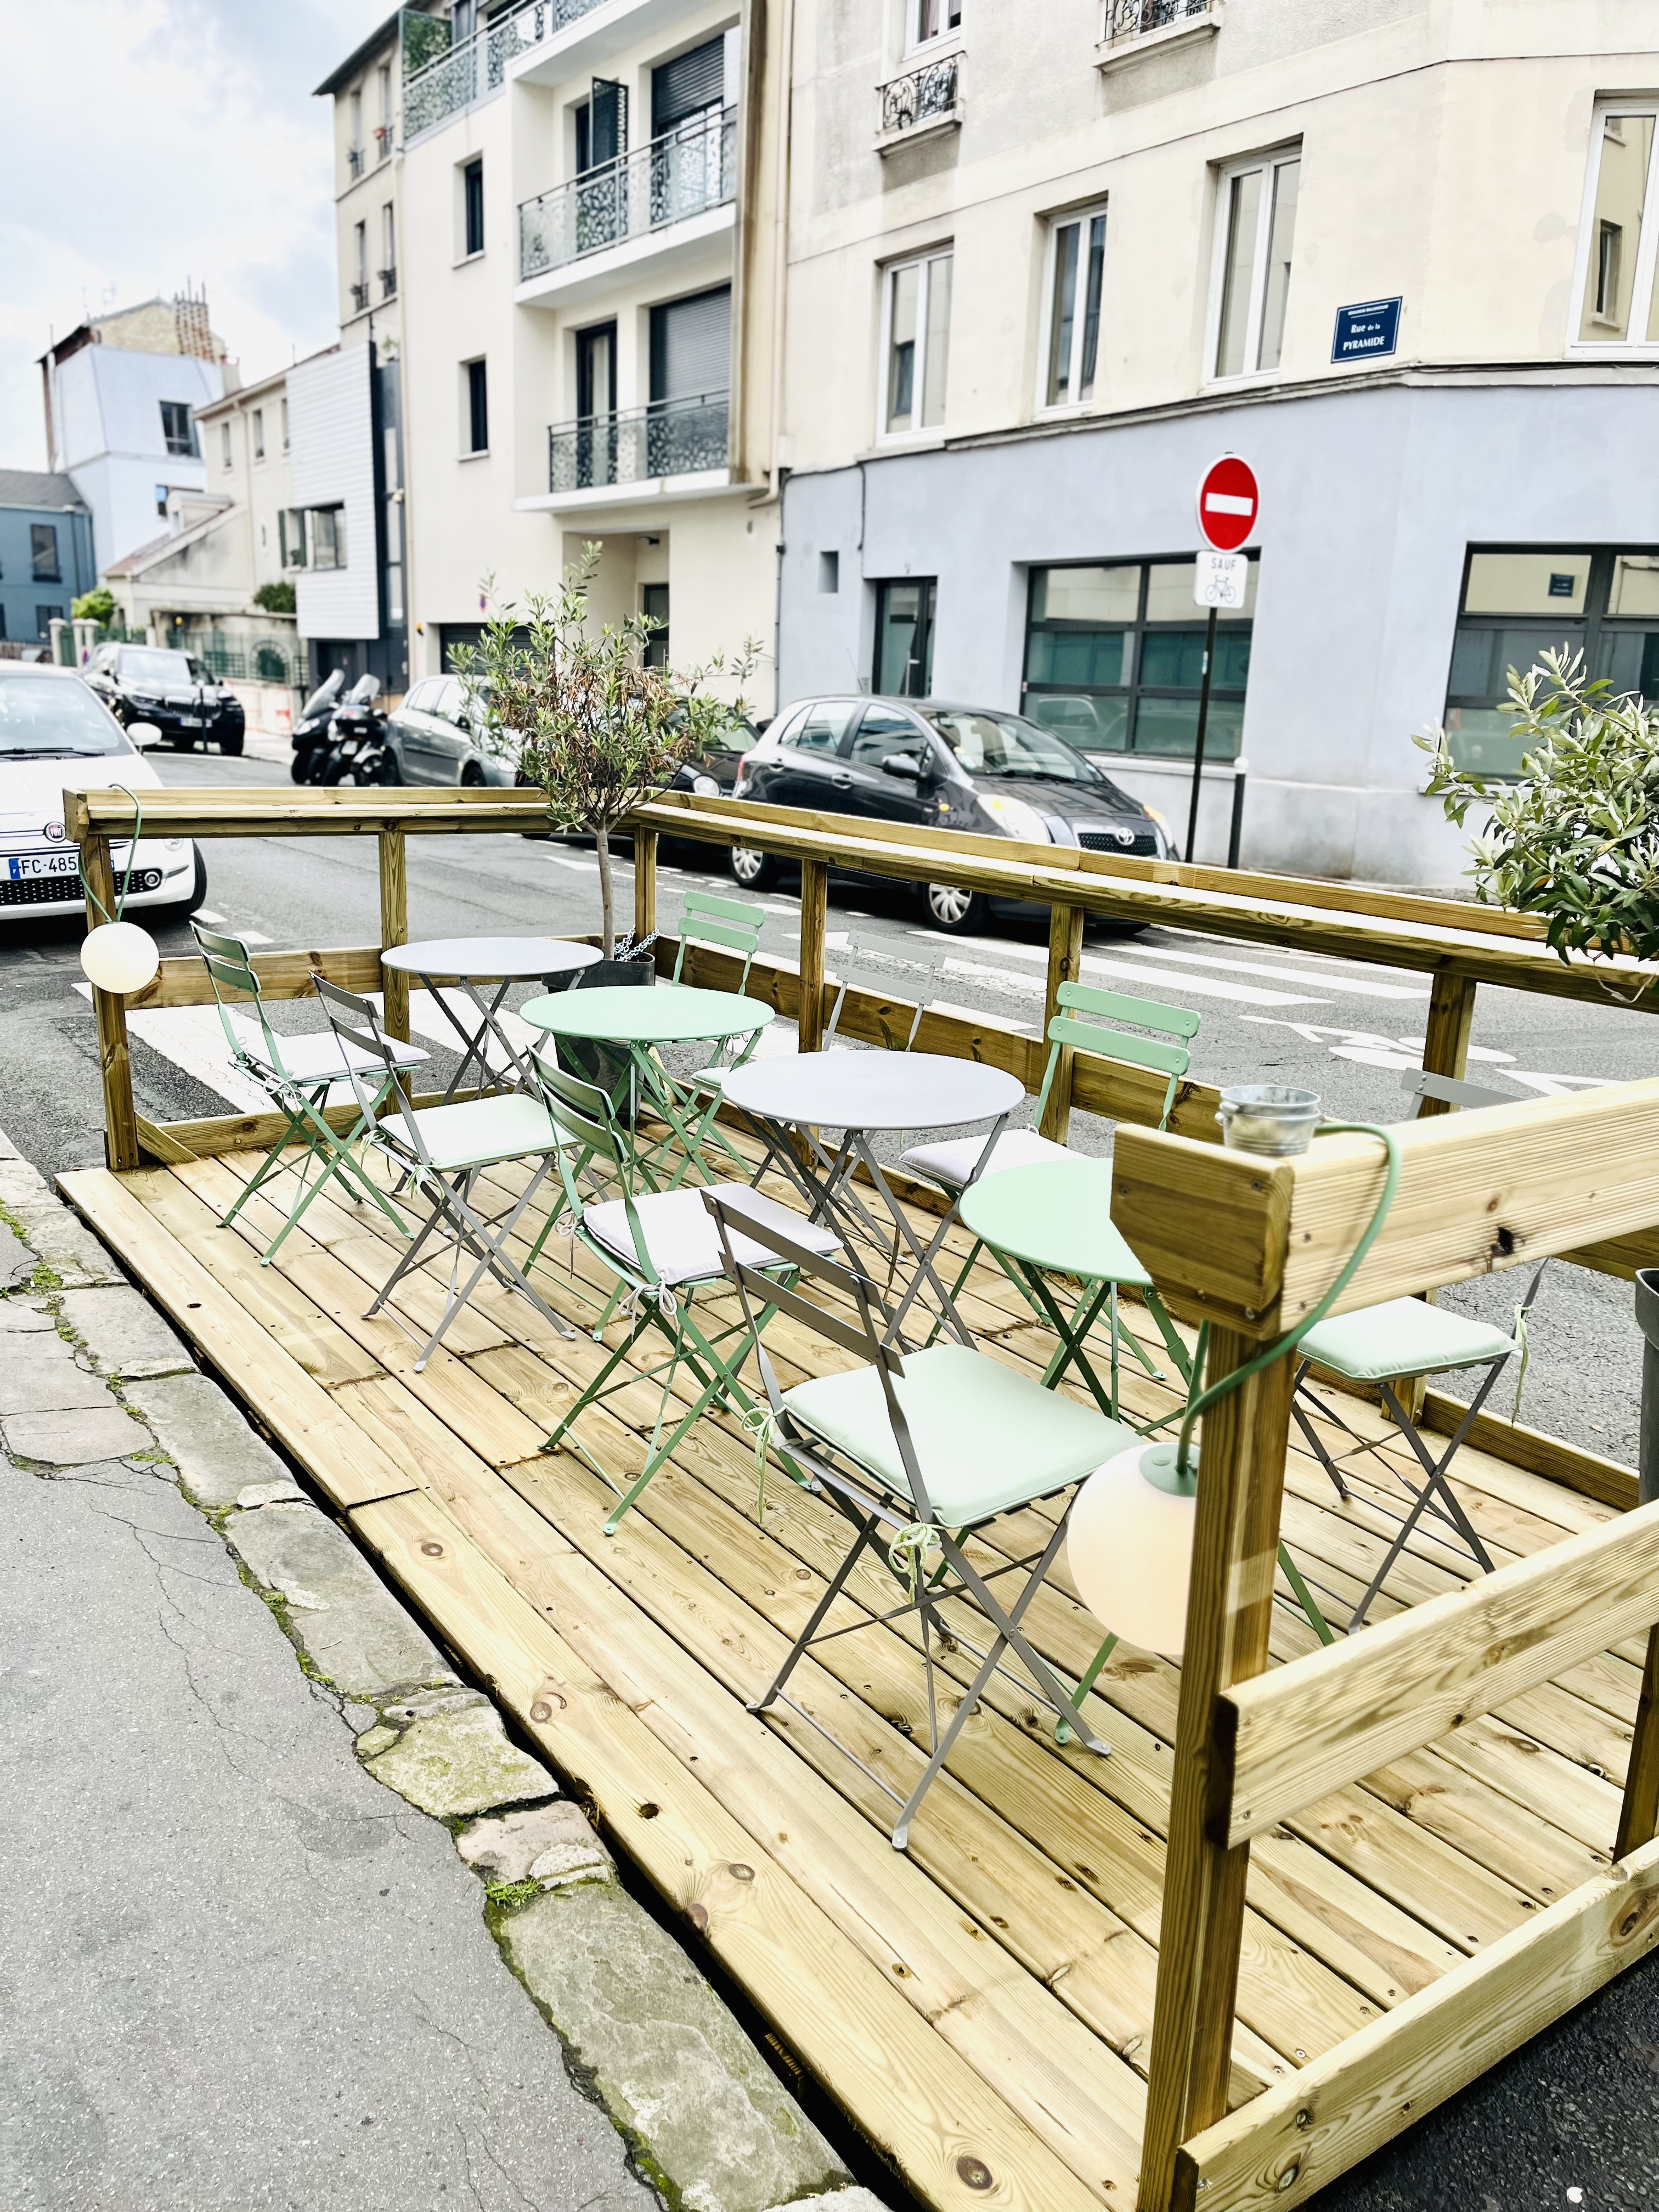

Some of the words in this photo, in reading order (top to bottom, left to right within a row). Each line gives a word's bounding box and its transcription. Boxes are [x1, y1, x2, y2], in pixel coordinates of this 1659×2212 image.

[1351, 324, 1366, 334] Rue
[1342, 335, 1386, 351] PYRAMIDE
[1211, 557, 1237, 571] SAUF
